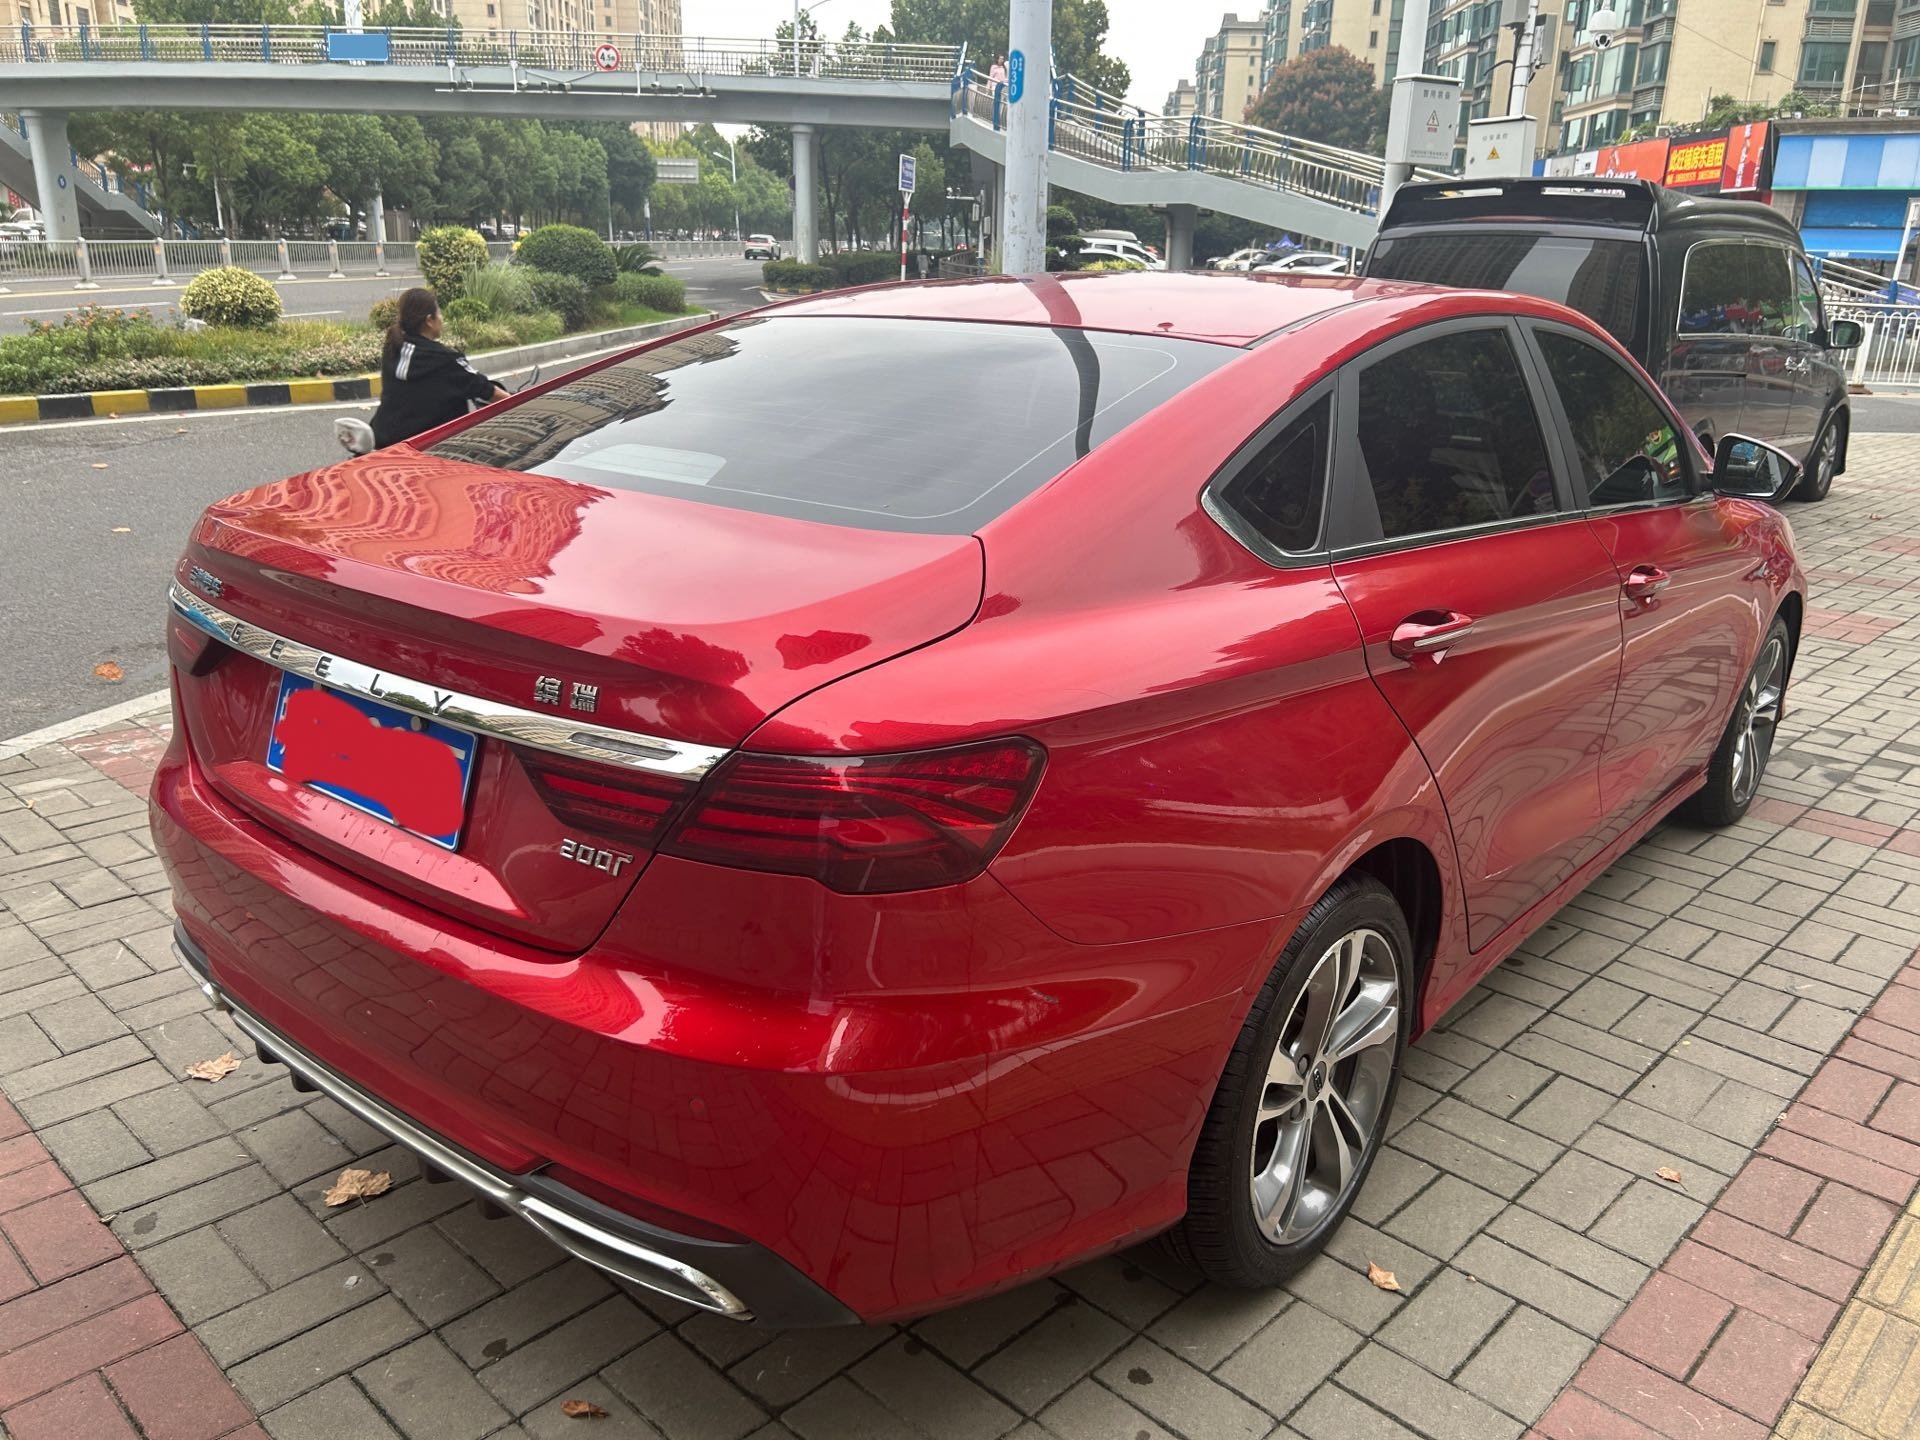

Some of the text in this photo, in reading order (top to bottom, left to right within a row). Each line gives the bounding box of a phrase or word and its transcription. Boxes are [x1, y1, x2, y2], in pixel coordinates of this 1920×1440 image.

[1010, 58, 1018, 96] 030
[229, 623, 453, 715] GEELY
[534, 675, 598, 713] 缤瑞
[560, 838, 633, 877] 200T
